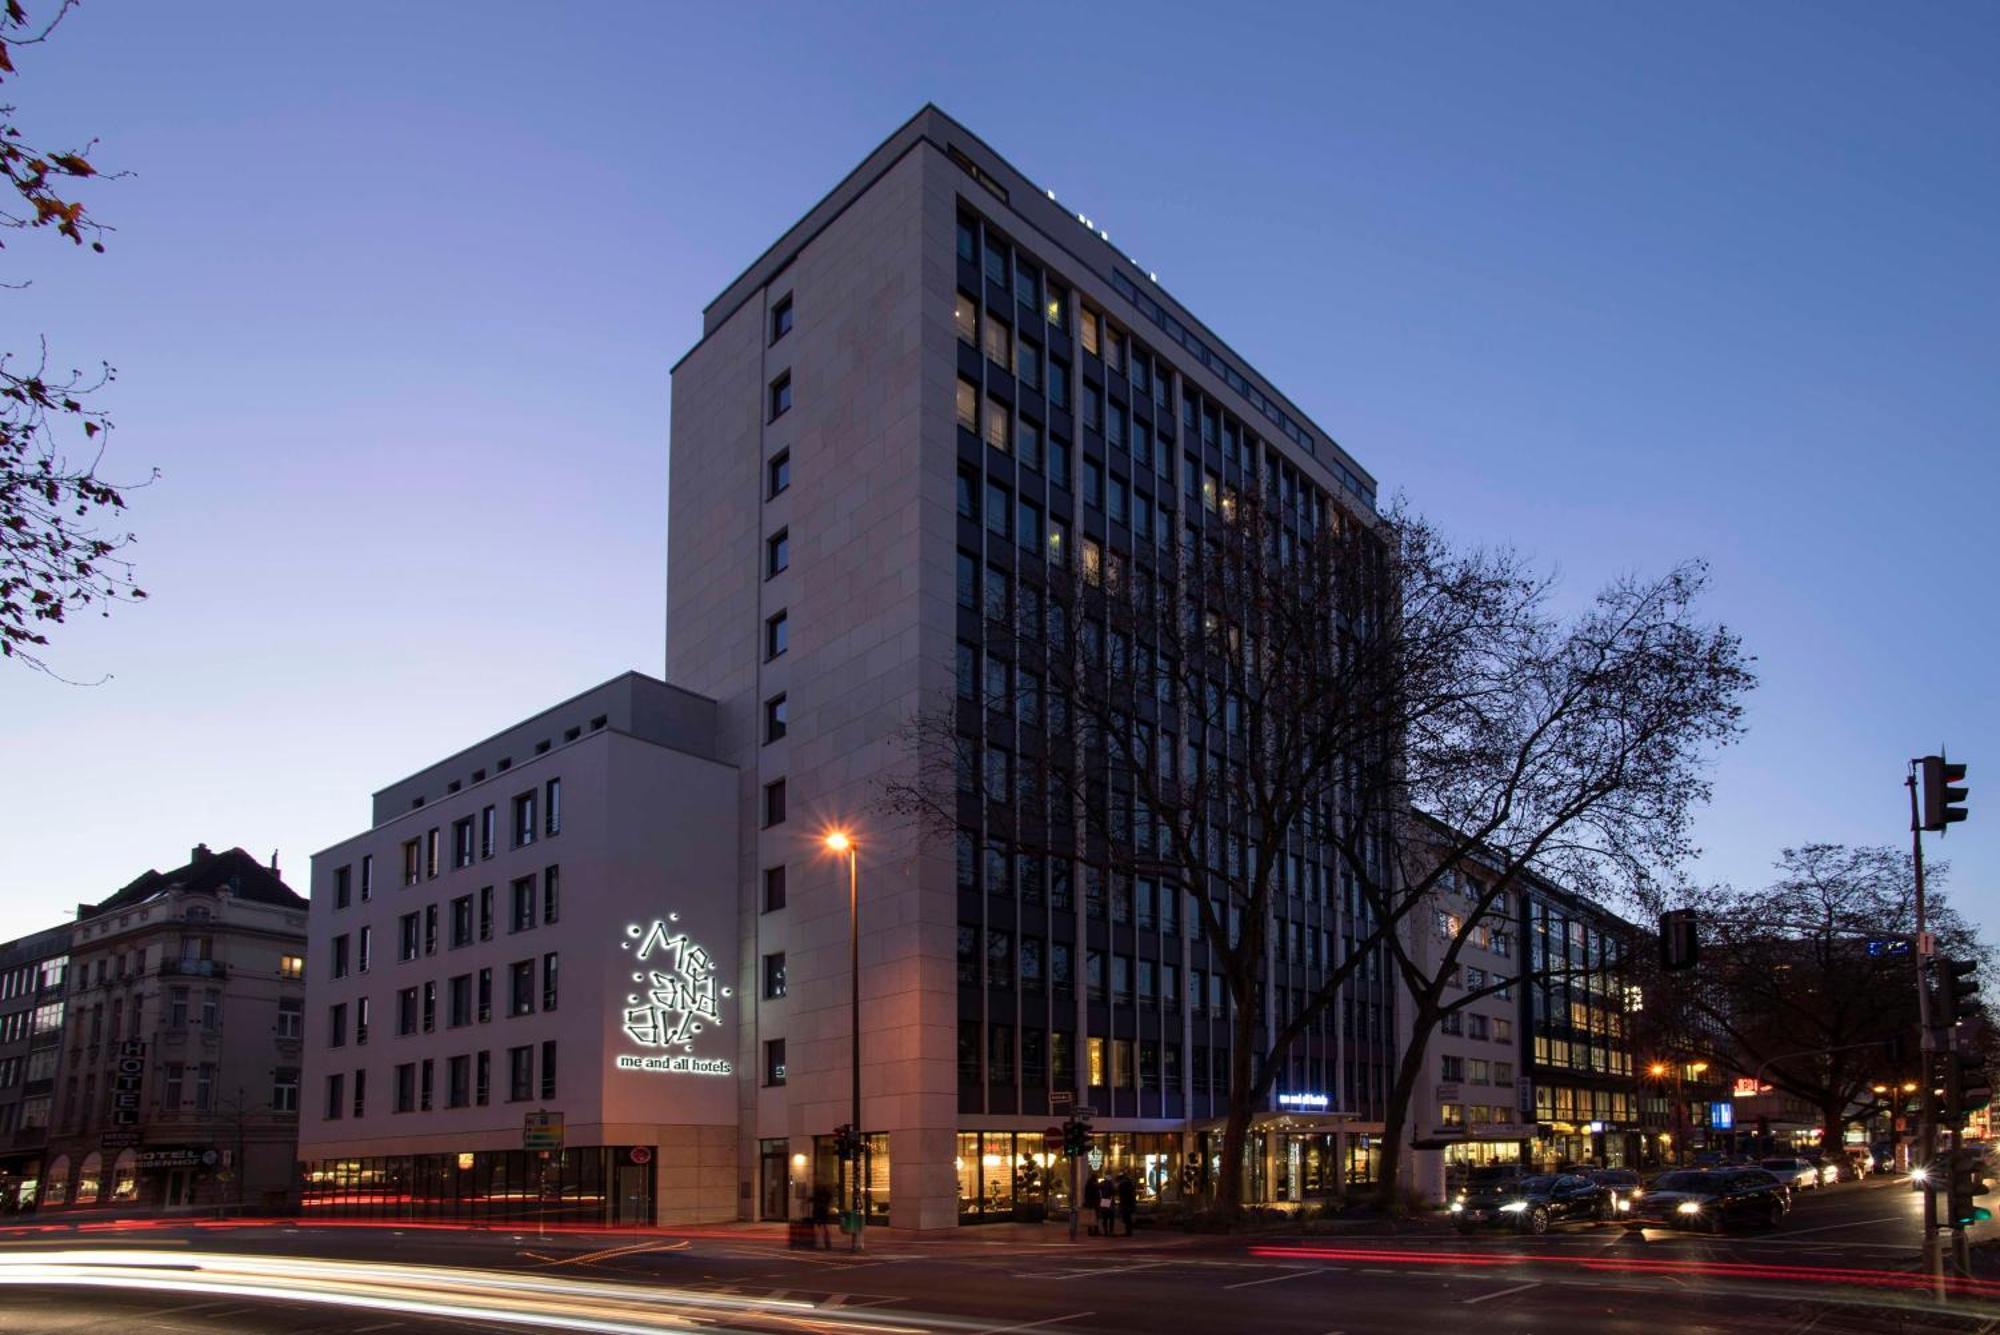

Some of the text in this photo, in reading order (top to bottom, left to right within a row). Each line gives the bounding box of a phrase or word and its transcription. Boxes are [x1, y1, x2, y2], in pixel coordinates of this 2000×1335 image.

[118, 1042, 143, 1124] HOTEL
[620, 1056, 731, 1073] me and all hotels
